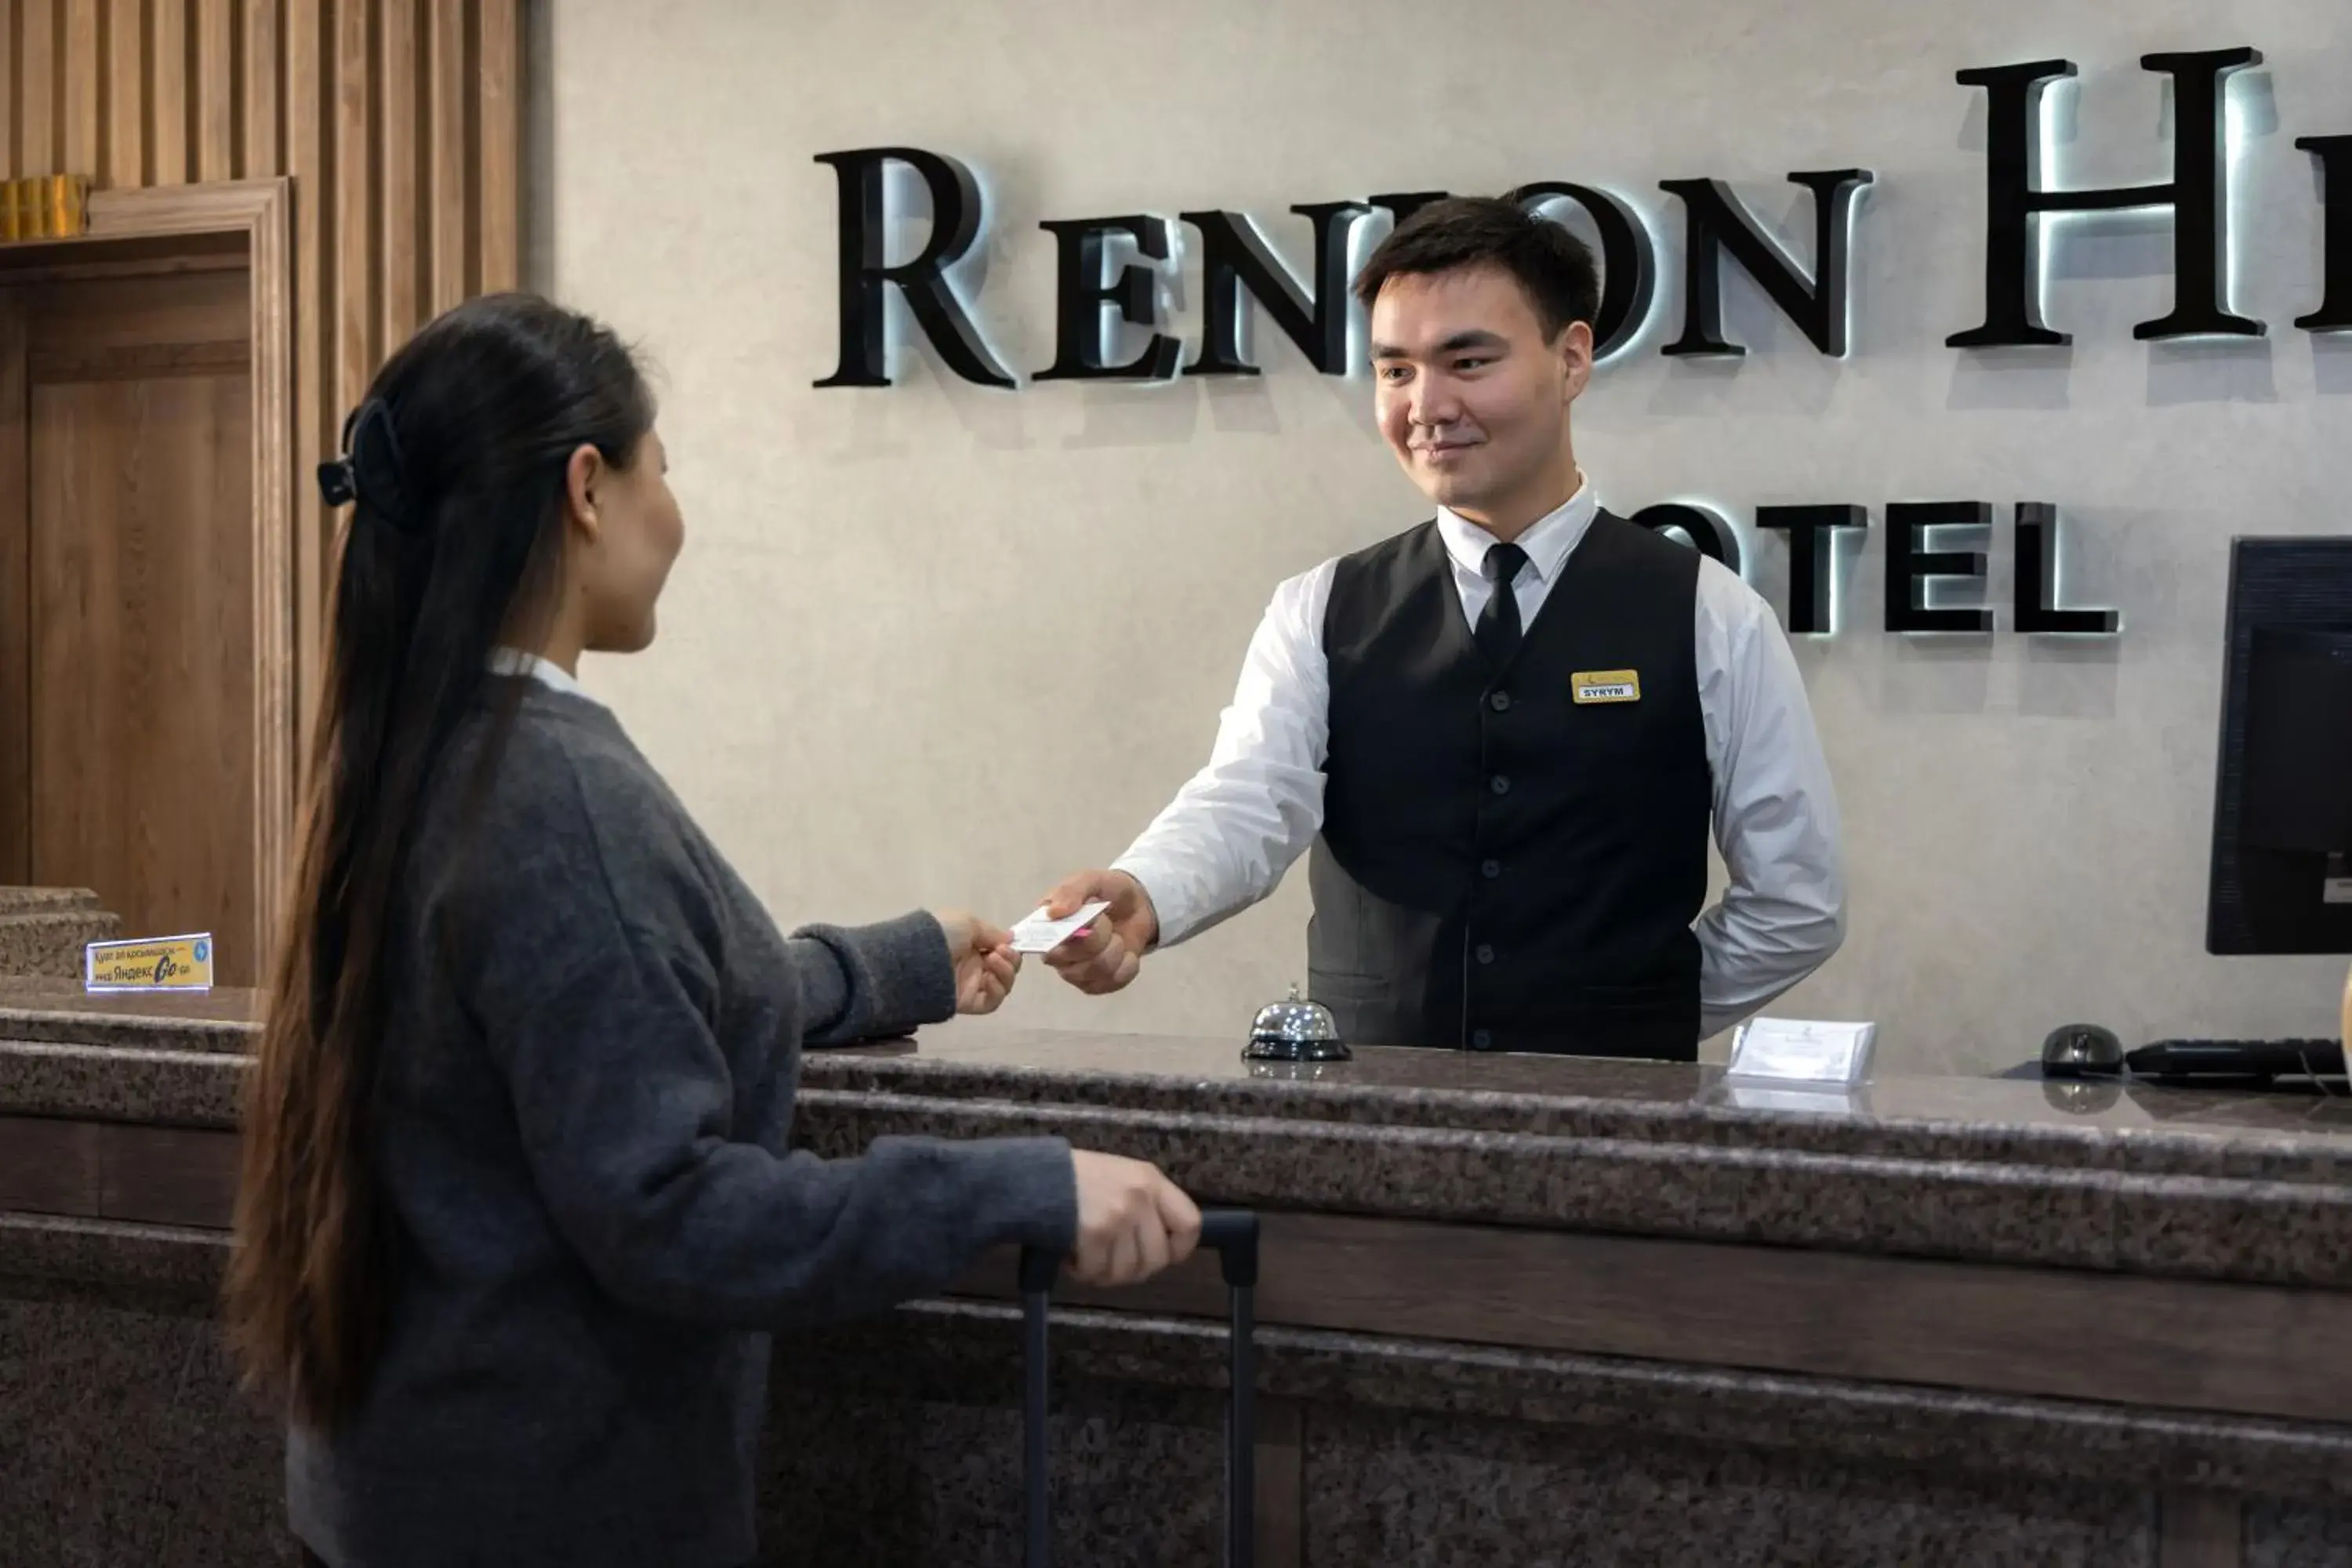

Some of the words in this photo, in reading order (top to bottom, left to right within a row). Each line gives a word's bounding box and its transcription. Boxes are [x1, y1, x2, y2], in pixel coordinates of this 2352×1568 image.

[813, 147, 1873, 389] RENON
[1583, 688, 1624, 697] SYRYM
[114, 965, 152, 982] Яндекс
